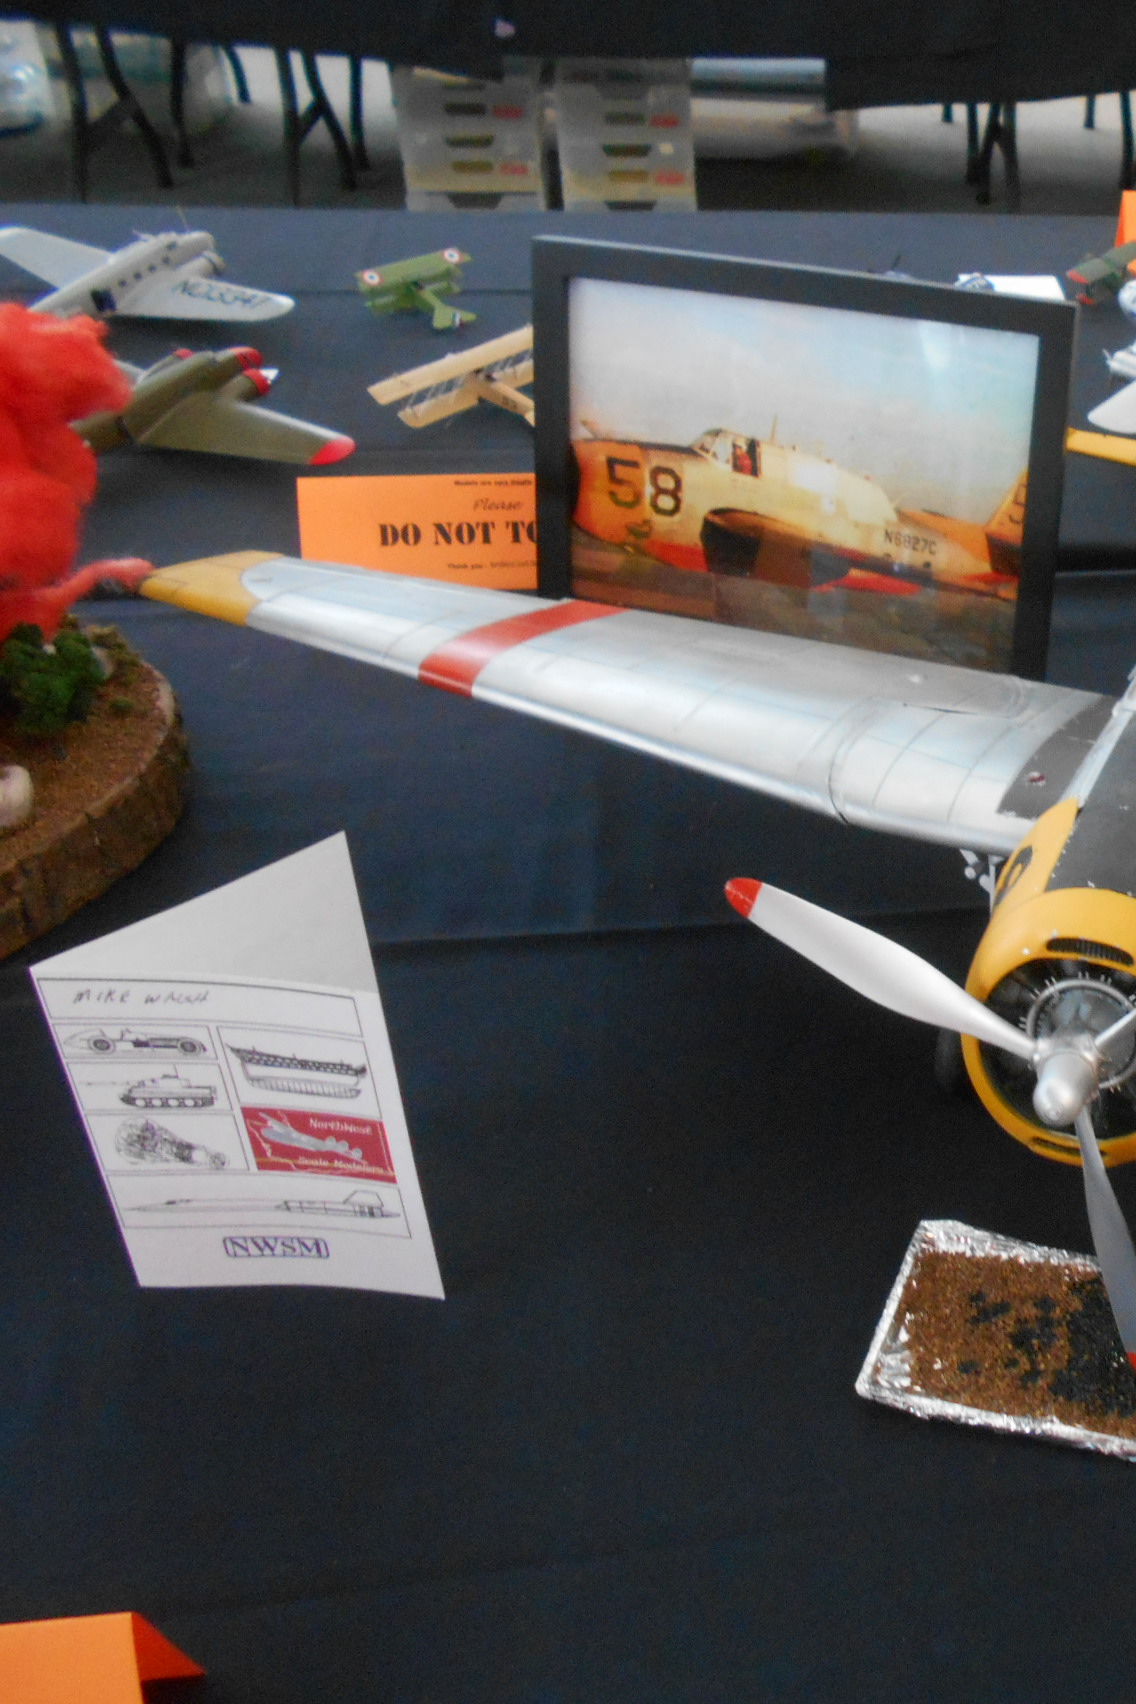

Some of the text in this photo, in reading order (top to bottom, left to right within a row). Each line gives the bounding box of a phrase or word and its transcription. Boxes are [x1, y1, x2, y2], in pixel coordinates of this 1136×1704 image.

[606, 456, 683, 517] 58
[473, 498, 522, 511] Please
[379, 523, 422, 547] DO
[434, 521, 496, 546] NOT
[228, 1236, 323, 1258] NWSM
